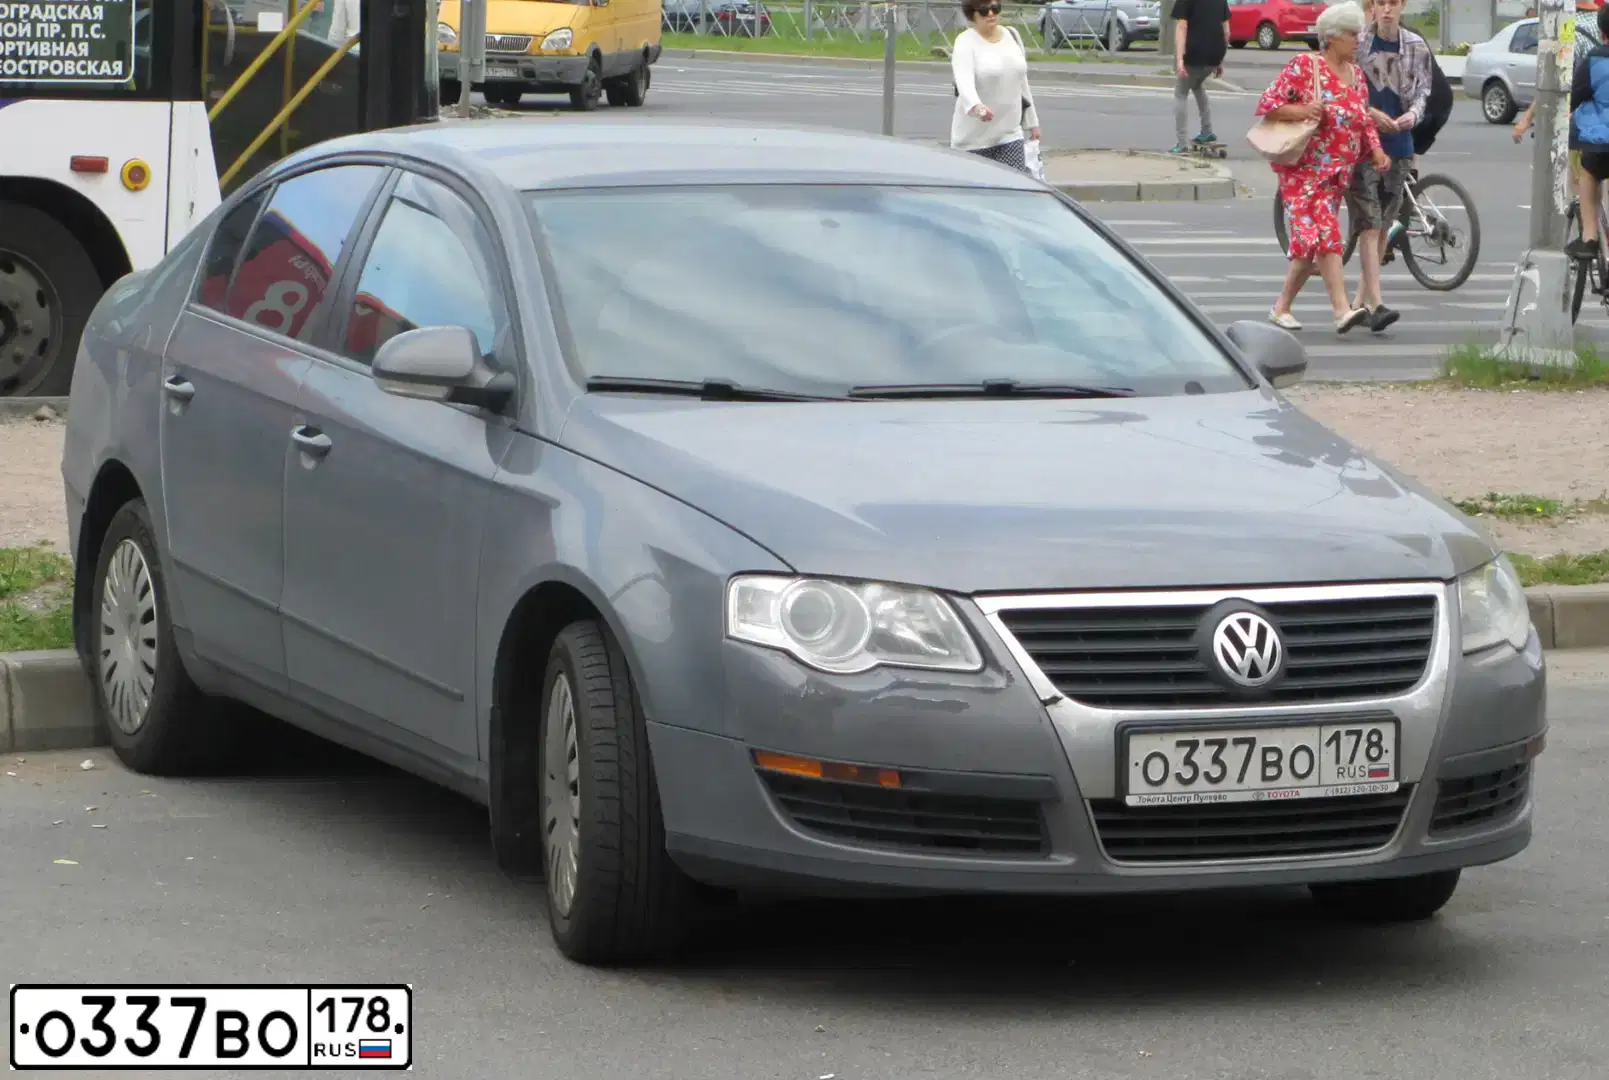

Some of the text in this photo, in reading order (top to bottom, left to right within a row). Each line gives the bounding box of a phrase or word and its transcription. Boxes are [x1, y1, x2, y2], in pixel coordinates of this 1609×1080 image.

[36, 22, 66, 38] ПР.
[71, 23, 106, 39] П.С.
[1325, 728, 1384, 765] 178
[1336, 765, 1367, 779] RUS
[1267, 790, 1300, 798] TOYOTA
